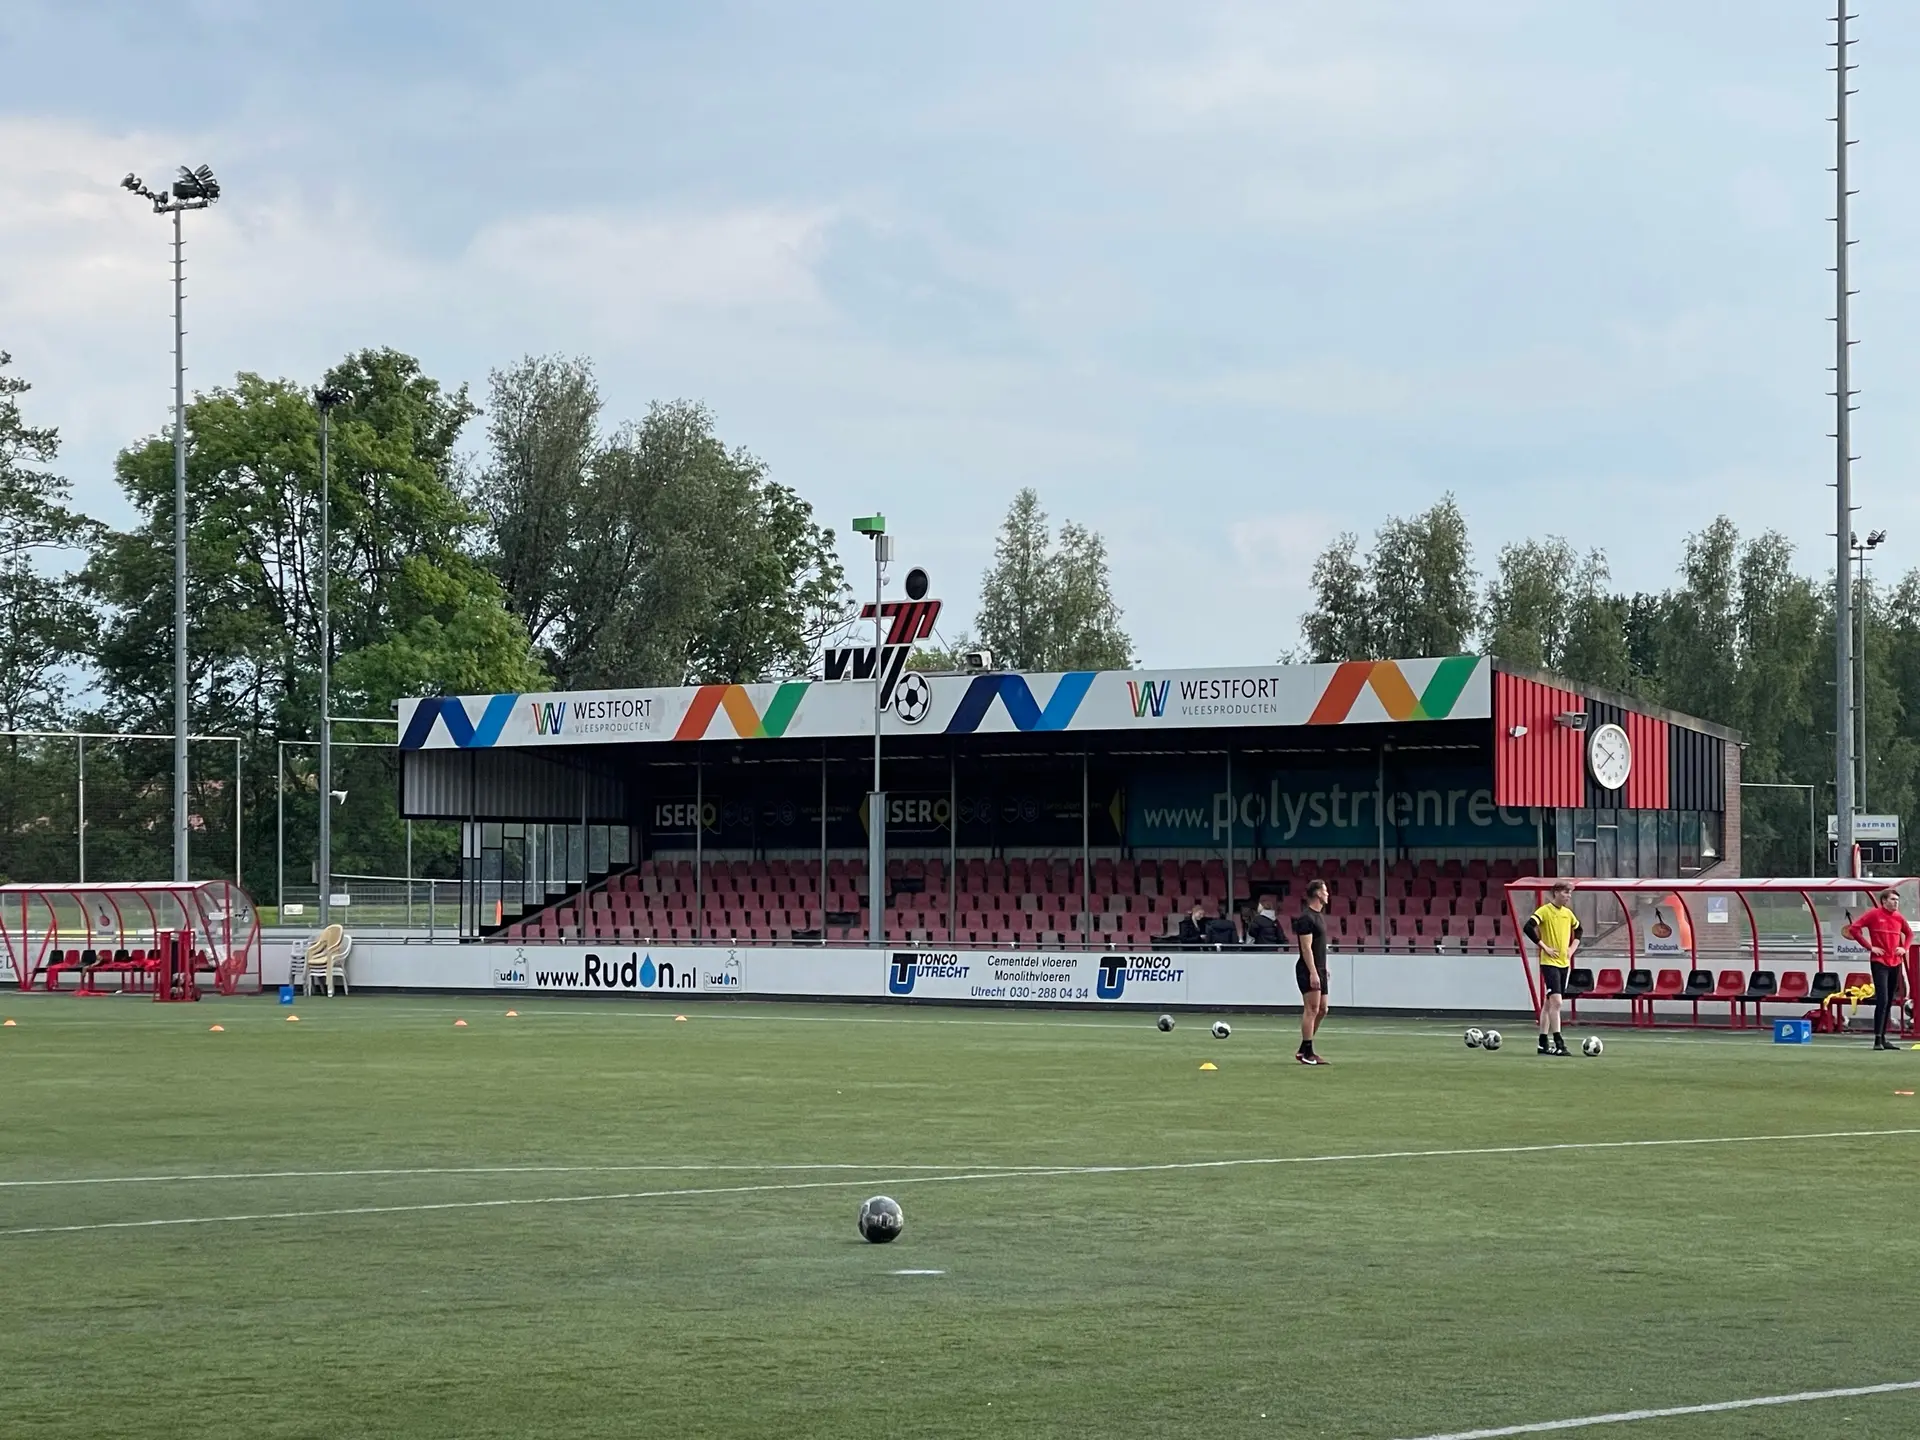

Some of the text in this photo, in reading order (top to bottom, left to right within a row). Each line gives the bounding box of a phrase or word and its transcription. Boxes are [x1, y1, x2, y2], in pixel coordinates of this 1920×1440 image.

[1180, 678, 1279, 700] WESTFORT
[573, 699, 652, 720] WESTFORT
[1182, 703, 1277, 715] VLEESPRODUCTEN
[575, 722, 650, 733] VLEESPRODUCTEN
[656, 801, 717, 827] ISERO
[885, 798, 950, 824] ISERO
[1648, 943, 1679, 951] Rabobank
[918, 953, 958, 966] TONCO
[1128, 956, 1171, 969] TONCO
[917, 965, 970, 978] UTRECHT
[994, 970, 1071, 982] Monolithvloeren
[1126, 969, 1184, 982] UTRECHT
[971, 986, 1006, 997] Utrecht
[1059, 988, 1073, 999] 04
[1075, 988, 1089, 999] 34
